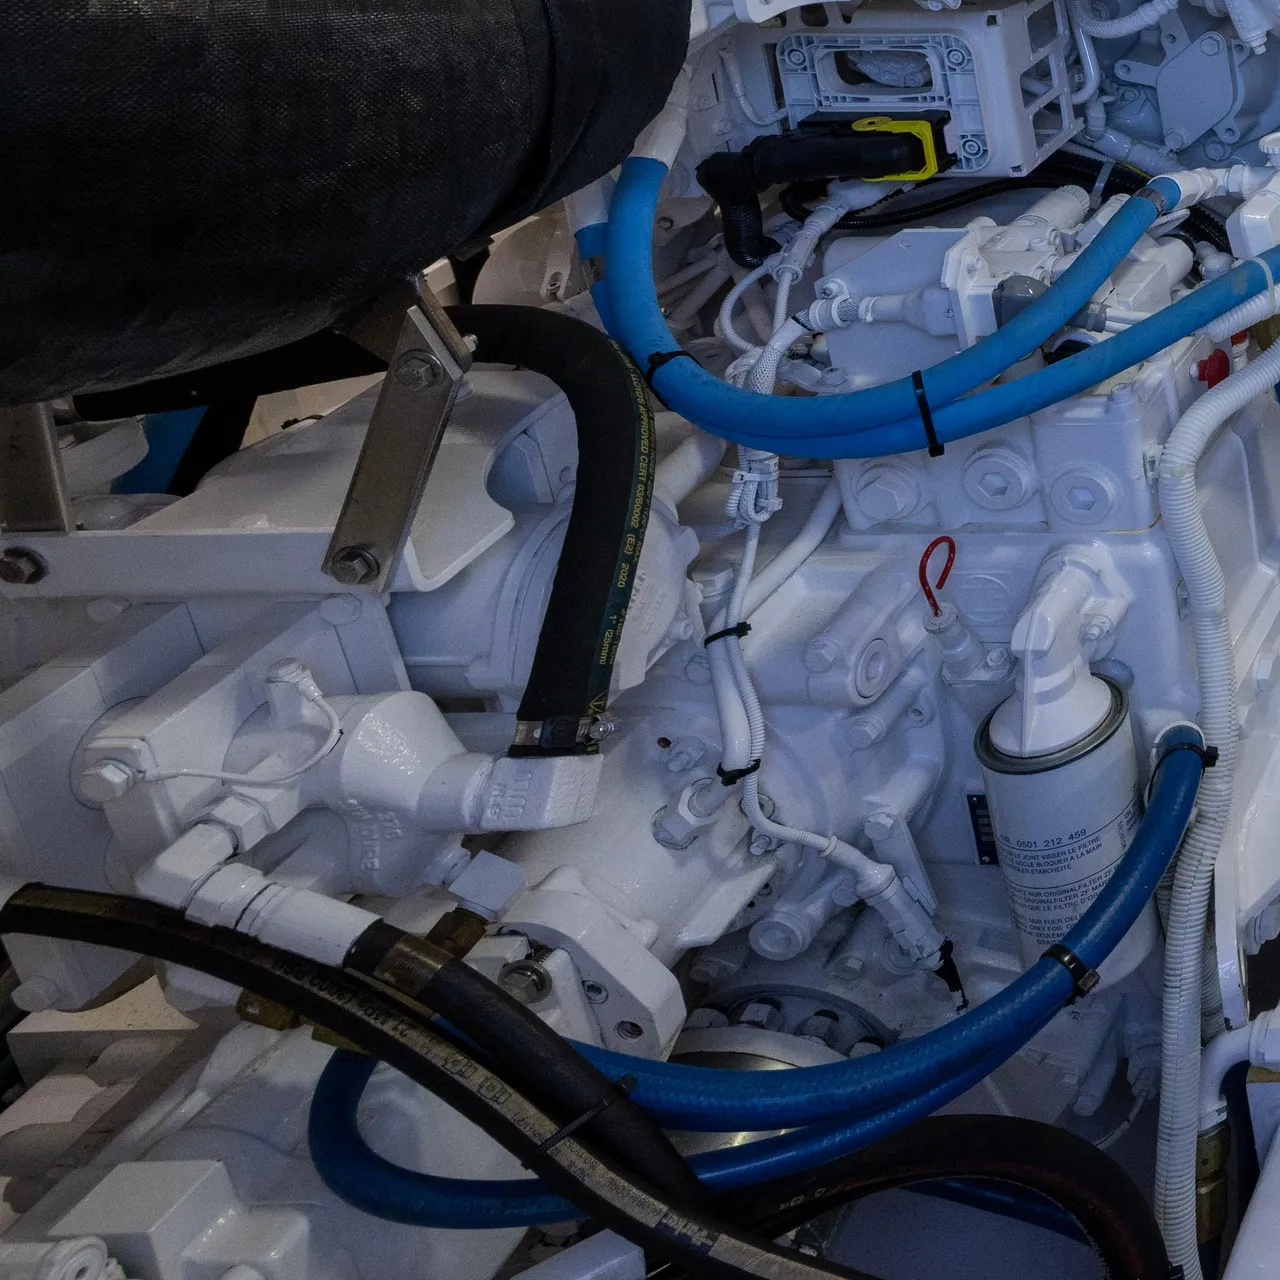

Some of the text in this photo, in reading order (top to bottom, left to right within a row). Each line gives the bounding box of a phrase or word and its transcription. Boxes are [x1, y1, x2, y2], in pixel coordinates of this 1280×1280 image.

[638, 404, 649, 454] APPROVED
[639, 455, 649, 483] CERT
[631, 483, 645, 528] 03/60002
[624, 533, 636, 555] (E2)
[617, 562, 629, 588] 2020
[600, 628, 613, 665] (25mm)
[1016, 841, 1037, 849] 0501
[1044, 837, 1063, 847] 212
[1068, 828, 1087, 840] 459
[1041, 851, 1067, 860] VISSER
[1078, 835, 1103, 850] FILTRE
[1035, 857, 1069, 868] BLOQUER
[1086, 842, 1103, 855] MAIN
[1031, 863, 1072, 875] ETANCHEITE
[1023, 893, 1079, 904] ORIGINALFILTER
[1080, 889, 1091, 898] ZF
[1043, 876, 1103, 898] ORIGINALFILTER
[1028, 904, 1042, 912] QUE
[1053, 899, 1079, 911] FILTRE
[1028, 917, 1043, 925] NUR
[1044, 917, 1064, 925] FUER
[1029, 924, 1046, 932] ONLY
[1047, 924, 1063, 932] FOR
